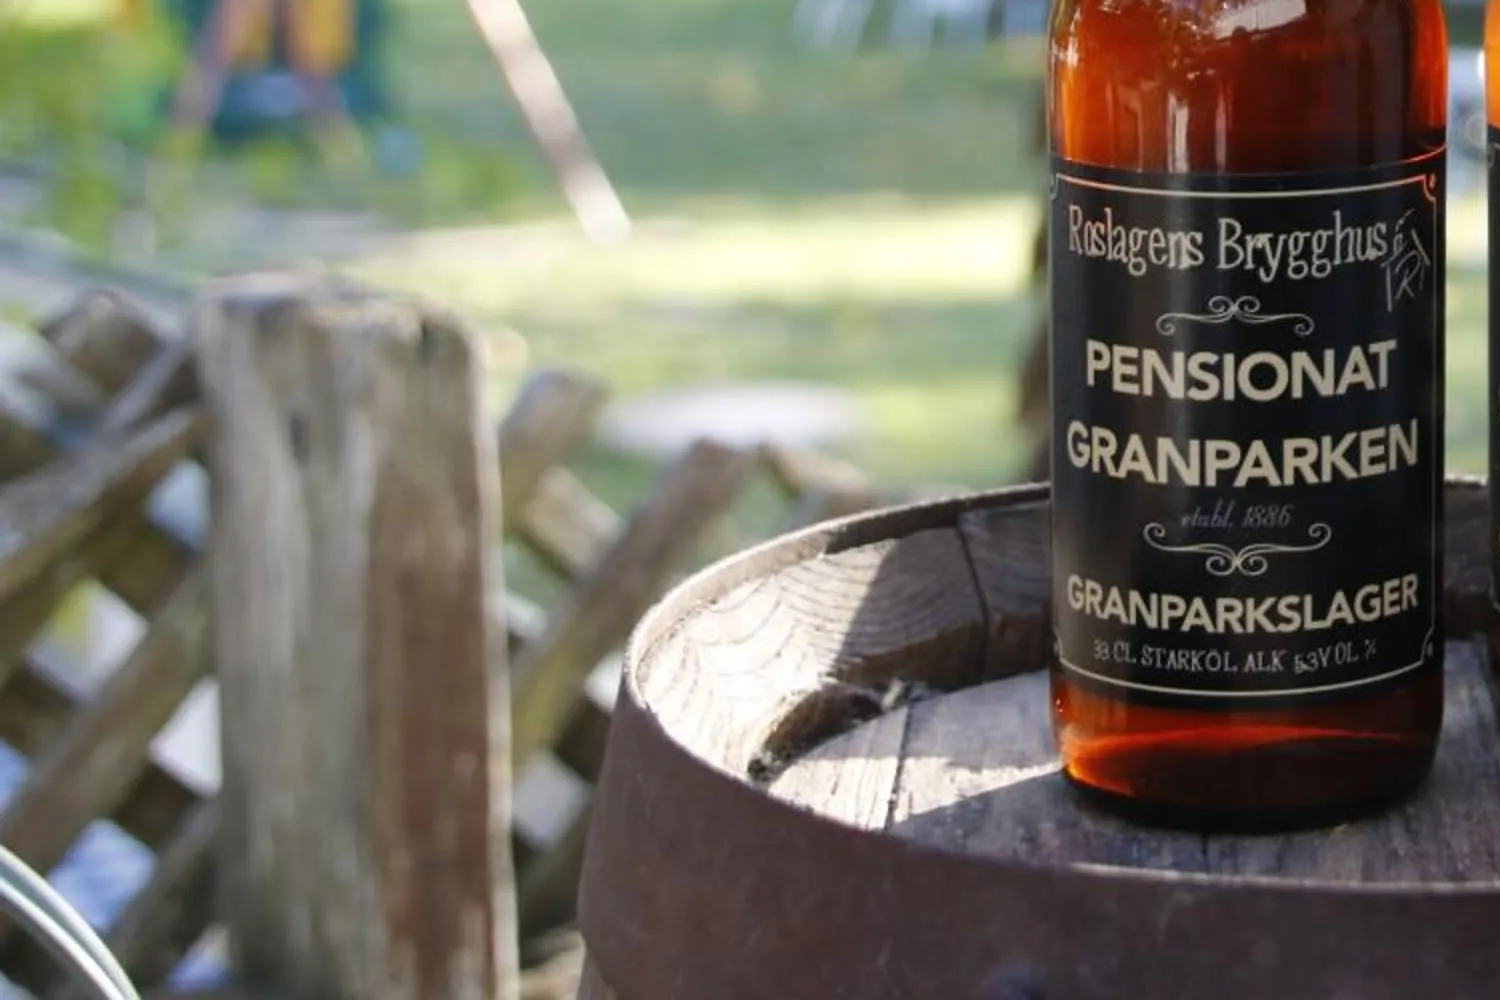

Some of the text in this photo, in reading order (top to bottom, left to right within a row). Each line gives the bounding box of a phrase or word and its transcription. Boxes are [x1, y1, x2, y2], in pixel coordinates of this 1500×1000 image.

[1068, 204, 1388, 284] Roslagens Brygghus
[1085, 338, 1398, 402] PENSIONAT
[1066, 418, 1420, 489] GRANPARKEN
[1241, 503, 1296, 529] 1886
[1066, 573, 1420, 635] GRANPARKSLAGER
[1243, 648, 1289, 673] ALK
